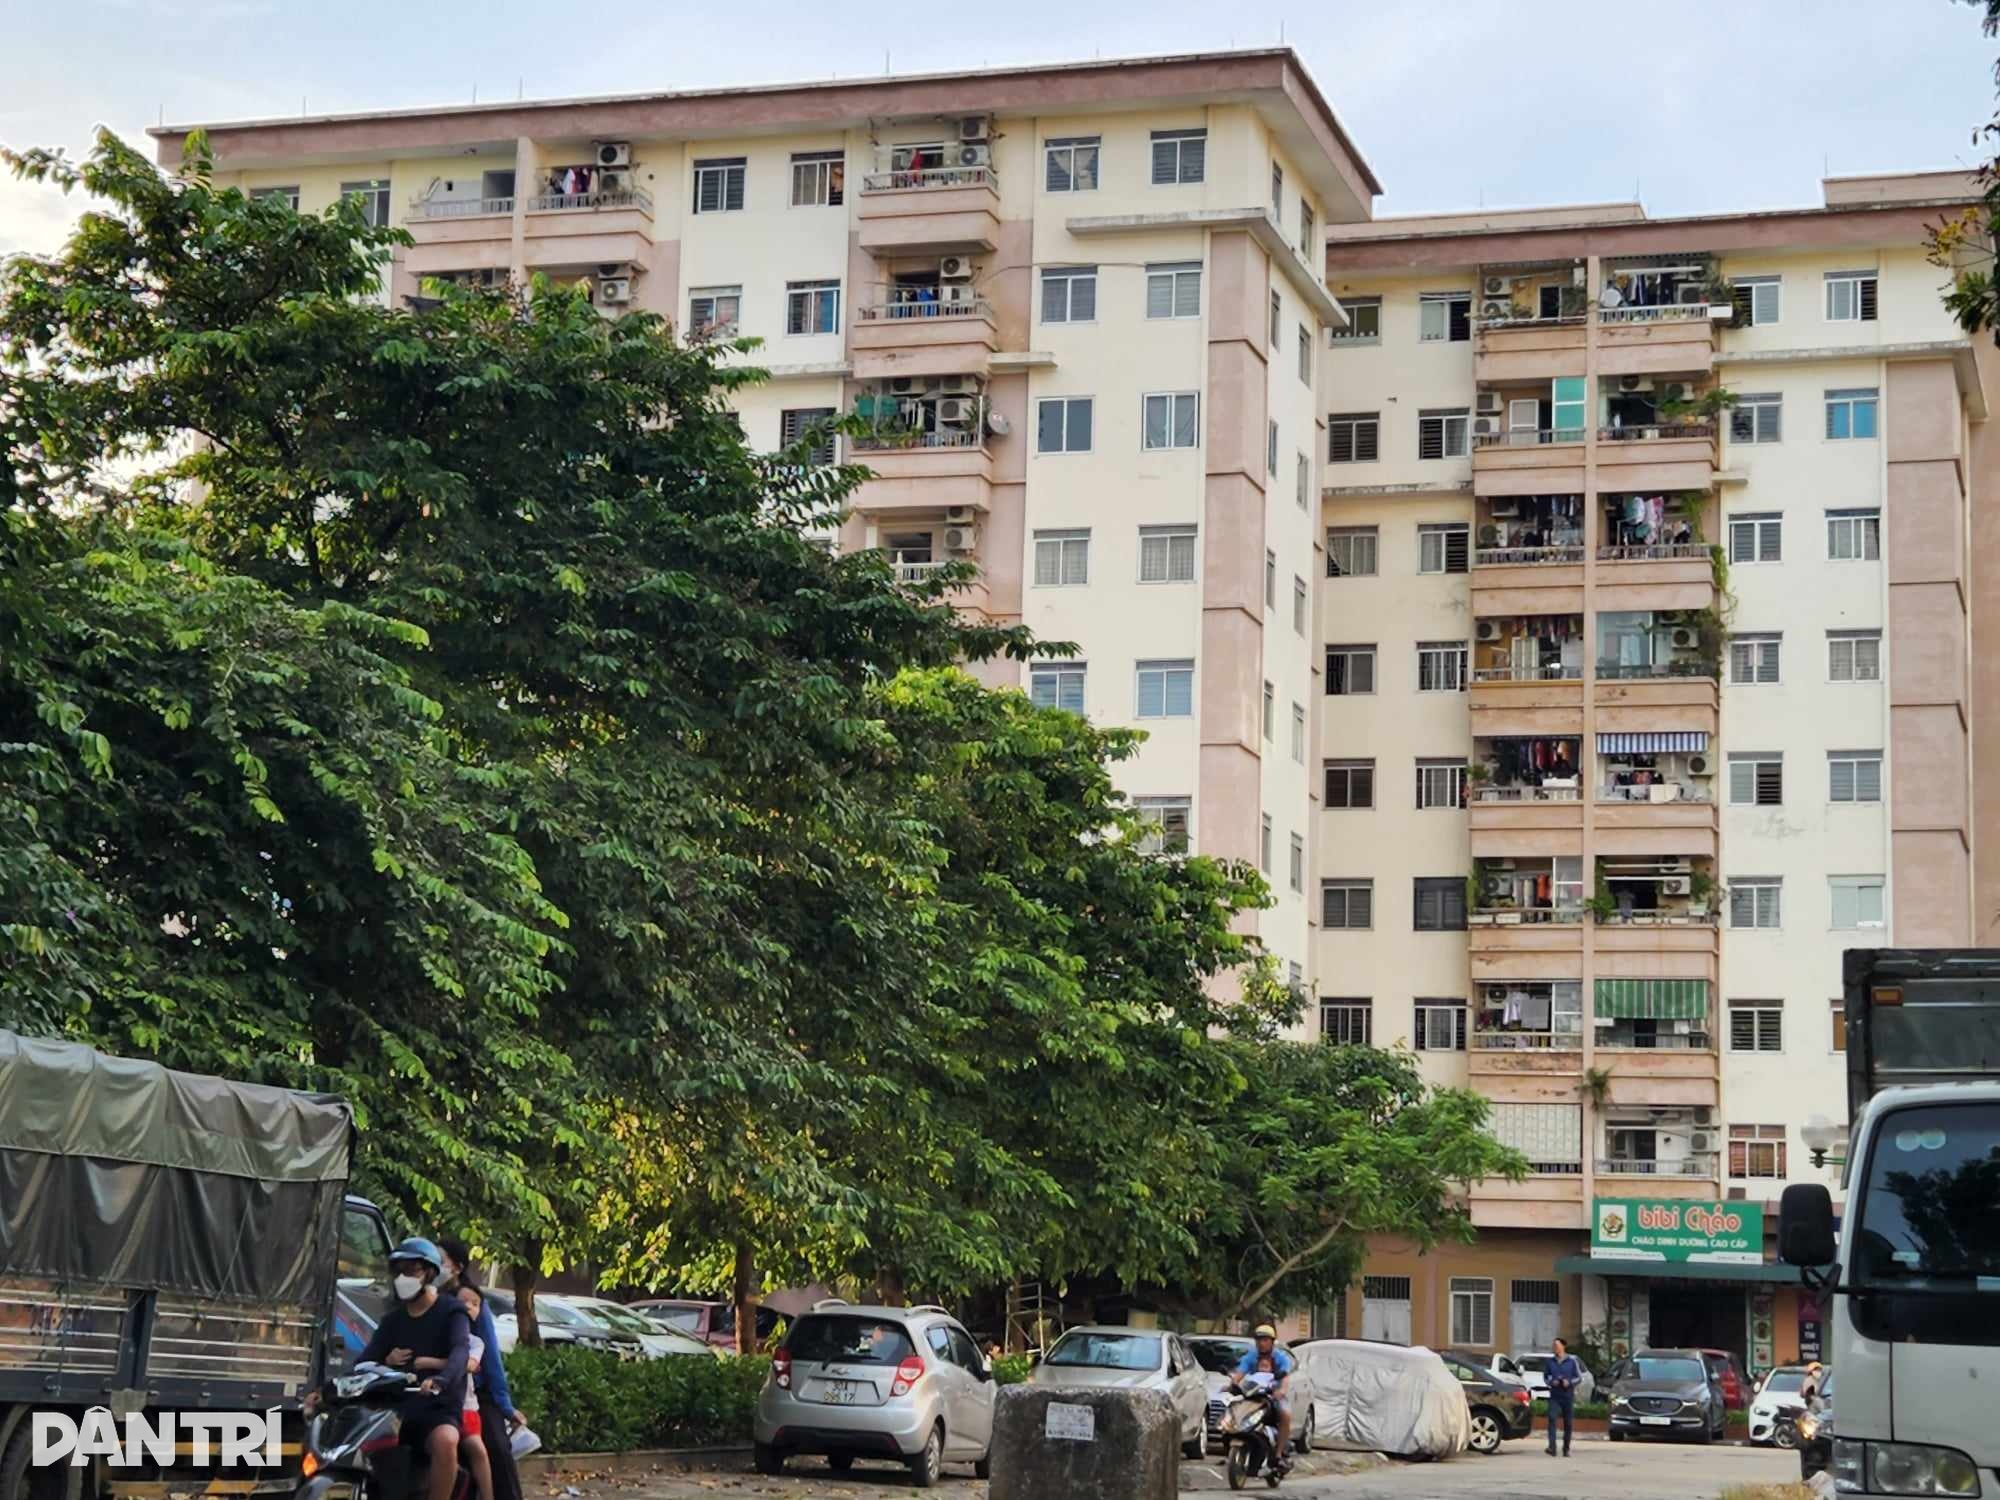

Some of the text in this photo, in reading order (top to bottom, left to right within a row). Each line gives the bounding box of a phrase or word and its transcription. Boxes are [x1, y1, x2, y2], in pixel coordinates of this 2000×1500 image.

[1638, 1203, 1741, 1237] bibi Cháo
[1710, 1239, 1728, 1248] CAO
